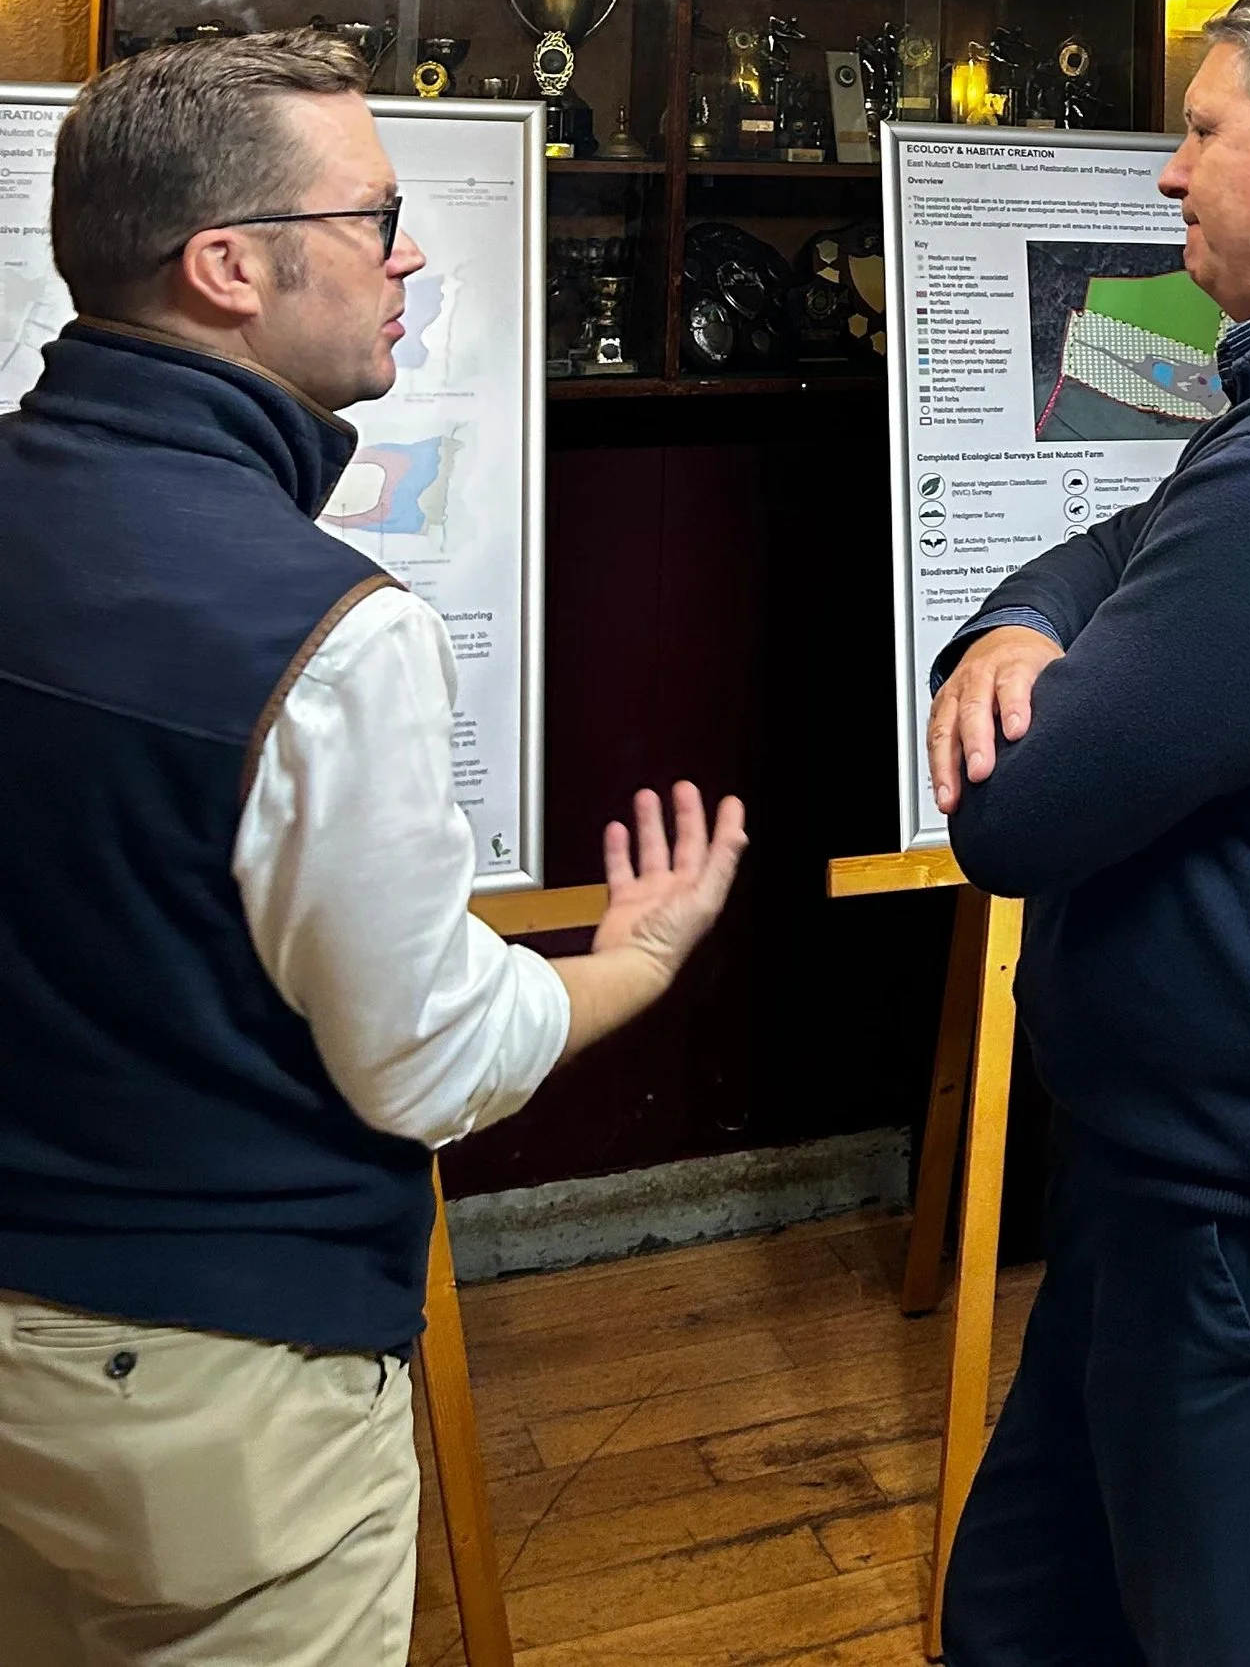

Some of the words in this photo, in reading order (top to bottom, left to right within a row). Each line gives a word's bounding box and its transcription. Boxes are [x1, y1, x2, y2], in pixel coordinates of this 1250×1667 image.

[907, 144, 954, 155] ECOLOGY
[957, 146, 963, 154] &
[966, 147, 1005, 156] HABITAT
[1007, 148, 1055, 158] CREATION
[907, 159, 924, 167] East
[925, 160, 951, 168] Nutcott
[952, 161, 973, 169] Clean
[975, 162, 991, 170] Inert
[1040, 165, 1078, 173] Restoration
[1095, 166, 1127, 175] Rewilding
[1128, 168, 1151, 176] Project
[907, 176, 944, 184] Overview
[1067, 200, 1098, 208] biodiversity
[1028, 207, 1055, 215] ecological
[915, 240, 928, 249] Key
[950, 358, 984, 366] (non-priority
[917, 453, 960, 463] Completed
[962, 452, 1002, 462] Ecological
[1004, 451, 1035, 461] Surveys
[1037, 451, 1054, 459] East
[1085, 450, 1104, 458] Farm
[978, 480, 1008, 488] Vegetation
[952, 489, 970, 497] (NVC)
[1120, 485, 1139, 493] Survey
[952, 512, 982, 520] Hedgerow
[984, 511, 1005, 519] Survey
[965, 537, 986, 545] Activity
[987, 536, 1011, 544] Surveys
[1012, 535, 1036, 543] (Manual
[921, 568, 968, 576] Biodiversity
[940, 588, 968, 596] Proposed
[926, 596, 963, 605] (Biodiversity
[442, 612, 493, 621] Monitoring
